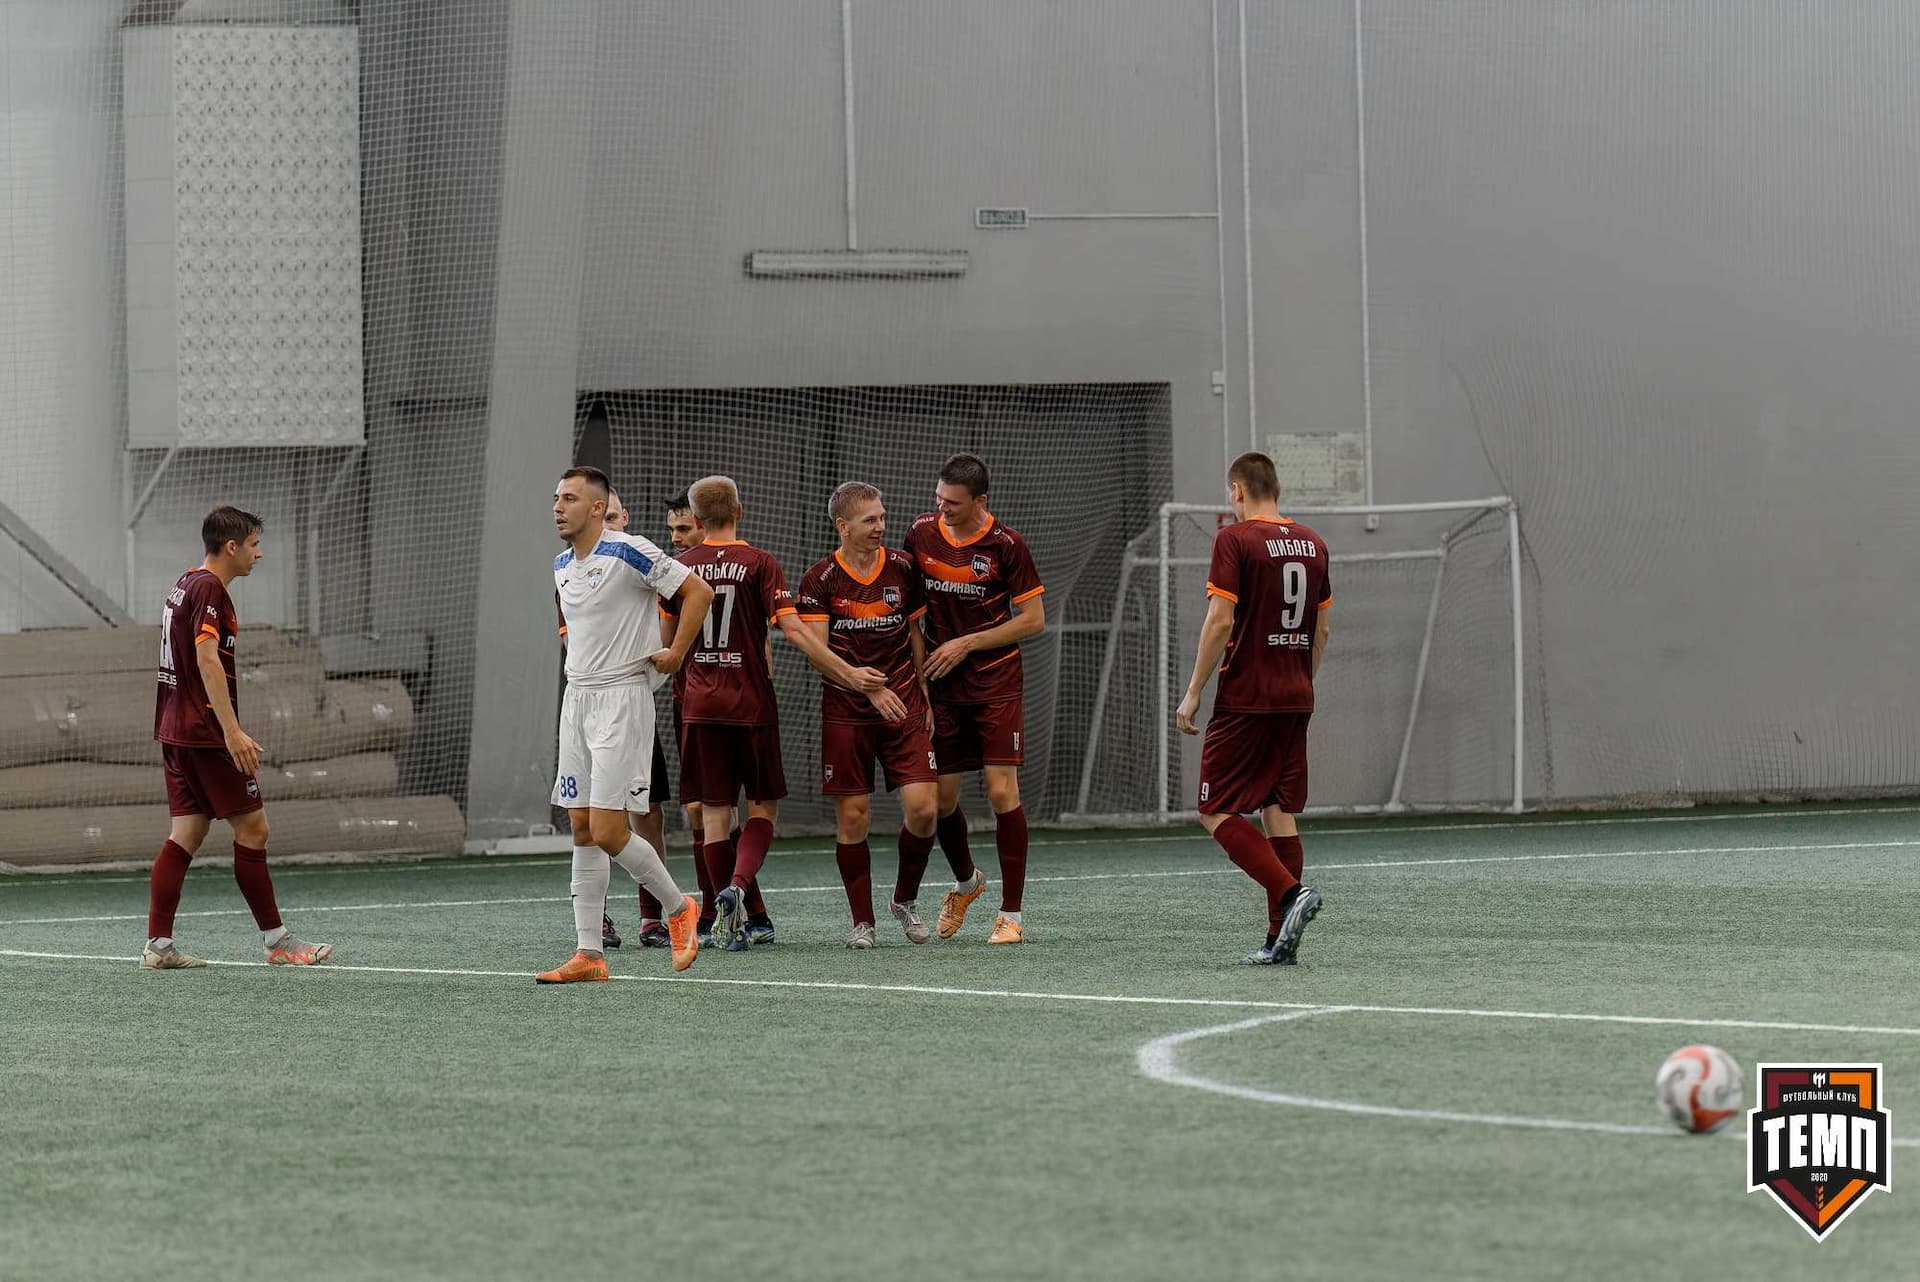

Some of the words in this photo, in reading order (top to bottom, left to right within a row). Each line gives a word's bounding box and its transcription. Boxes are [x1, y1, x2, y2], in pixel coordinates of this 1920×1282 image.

[1265, 539, 1317, 557] ШИБАЕВ
[1281, 562, 1307, 629] 9
[1267, 633, 1310, 646] SEUS
[693, 652, 743, 664] SEUS
[560, 775, 578, 799] 88
[1200, 782, 1210, 801] 9
